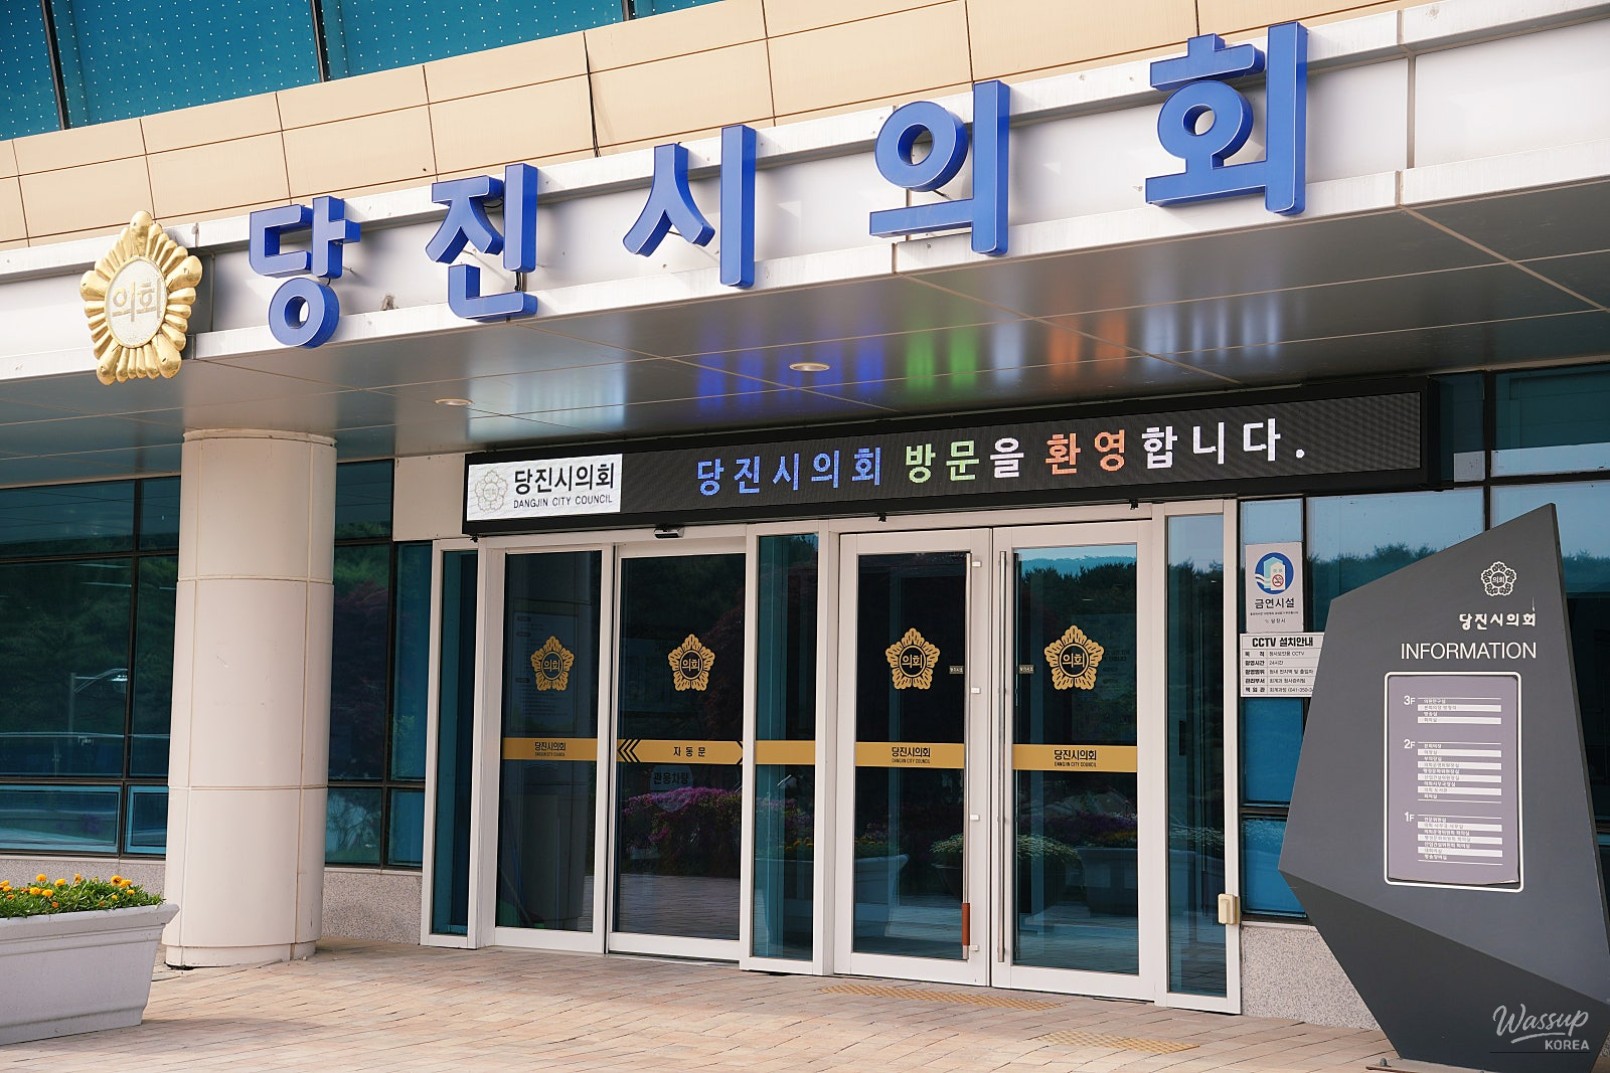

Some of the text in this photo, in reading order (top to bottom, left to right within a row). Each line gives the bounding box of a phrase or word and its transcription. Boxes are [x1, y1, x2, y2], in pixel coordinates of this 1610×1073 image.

[112, 280, 162, 322] 의회
[697, 418, 1305, 496] 당진시의회 방문을 환영합니다.
[514, 462, 614, 495] 당진시의회
[513, 494, 613, 509] DANGJIN CITY COUNCIL
[1255, 597, 1294, 609] 금연시설
[1459, 612, 1536, 630] 당진시의회
[1252, 637, 1314, 648] CCTV 설치안내
[1401, 642, 1537, 660] INFORMATION
[543, 659, 560, 673] 의회
[682, 658, 700, 671] 의회
[901, 654, 922, 669] 의회
[1062, 652, 1085, 668] 의회
[1403, 695, 1416, 705] 3F
[534, 741, 566, 751] 당진시의회
[1403, 738, 1416, 749] 2F
[673, 746, 706, 757] 자동문
[891, 746, 931, 757] 당진시의회
[1054, 749, 1097, 761] 당진시의회
[1404, 811, 1415, 822] 1F
